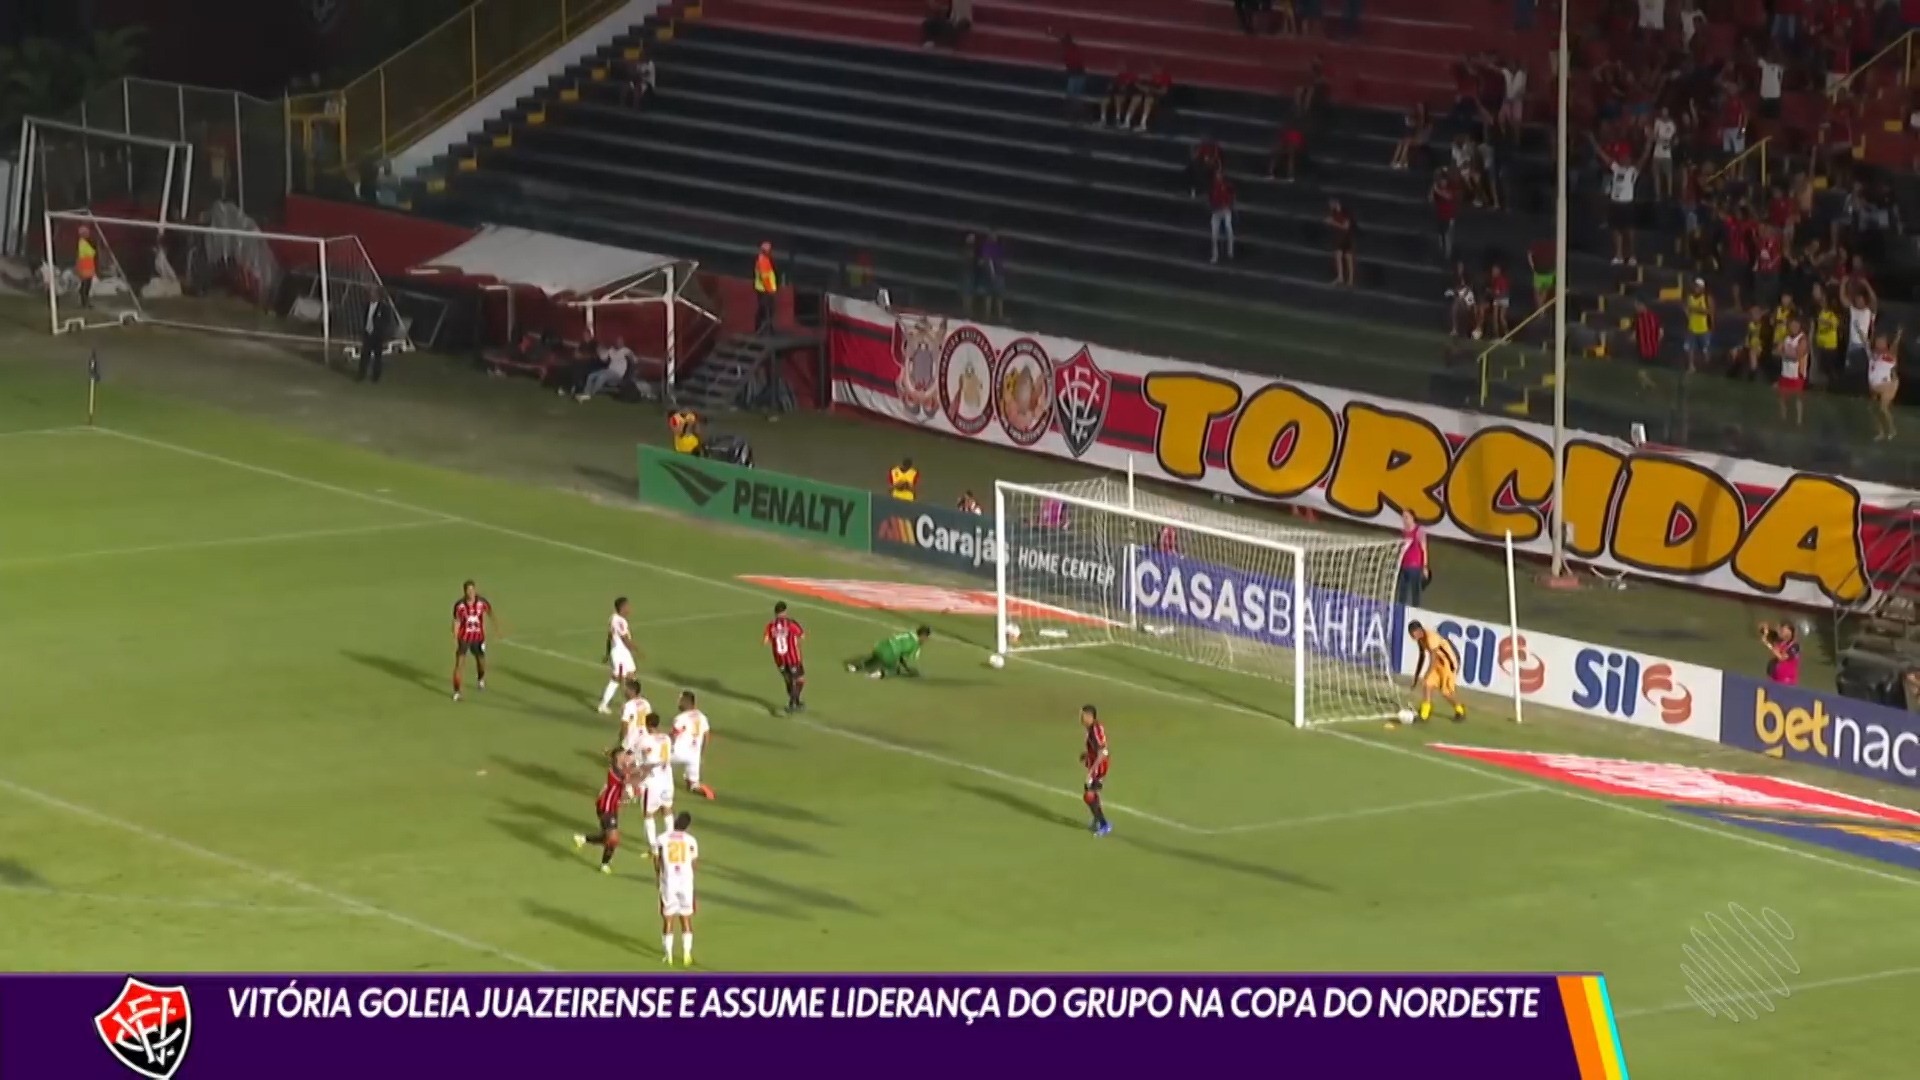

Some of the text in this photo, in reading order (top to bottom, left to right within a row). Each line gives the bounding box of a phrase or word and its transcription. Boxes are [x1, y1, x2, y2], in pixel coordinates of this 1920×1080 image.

[733, 477, 855, 537] PENALTY
[1143, 370, 1869, 601] TORCIDA
[1018, 545, 1058, 575] HOME
[1062, 554, 1116, 587] CENTER
[1571, 647, 1640, 718] Sil
[667, 840, 687, 864] 21
